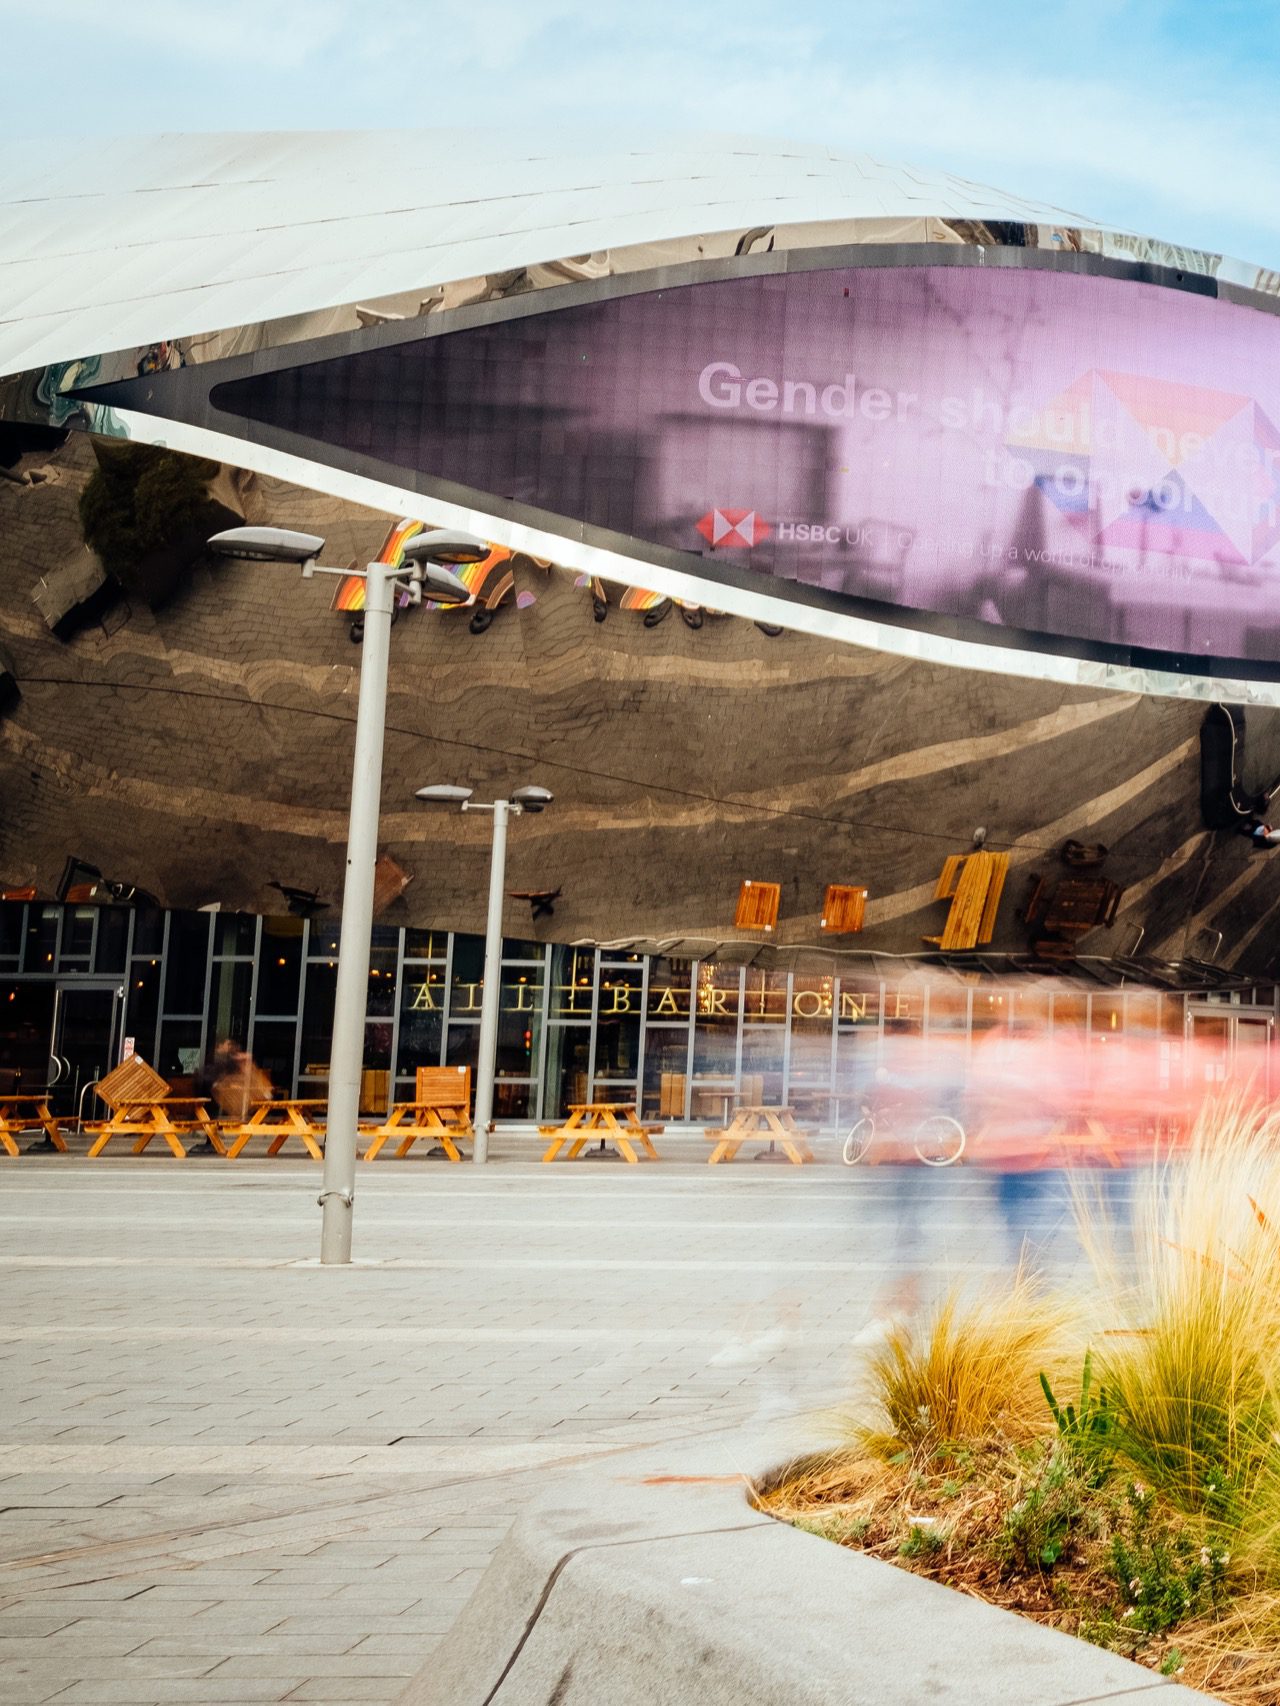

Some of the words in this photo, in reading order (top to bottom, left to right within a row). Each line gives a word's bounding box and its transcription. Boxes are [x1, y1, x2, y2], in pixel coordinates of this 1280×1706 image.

[698, 361, 919, 423] Gender
[939, 386, 1127, 453] should
[983, 448, 1036, 491] to
[778, 522, 841, 543] HSBC
[846, 528, 874, 546] UK
[1008, 546, 1018, 559] a
[1025, 547, 1073, 567] world
